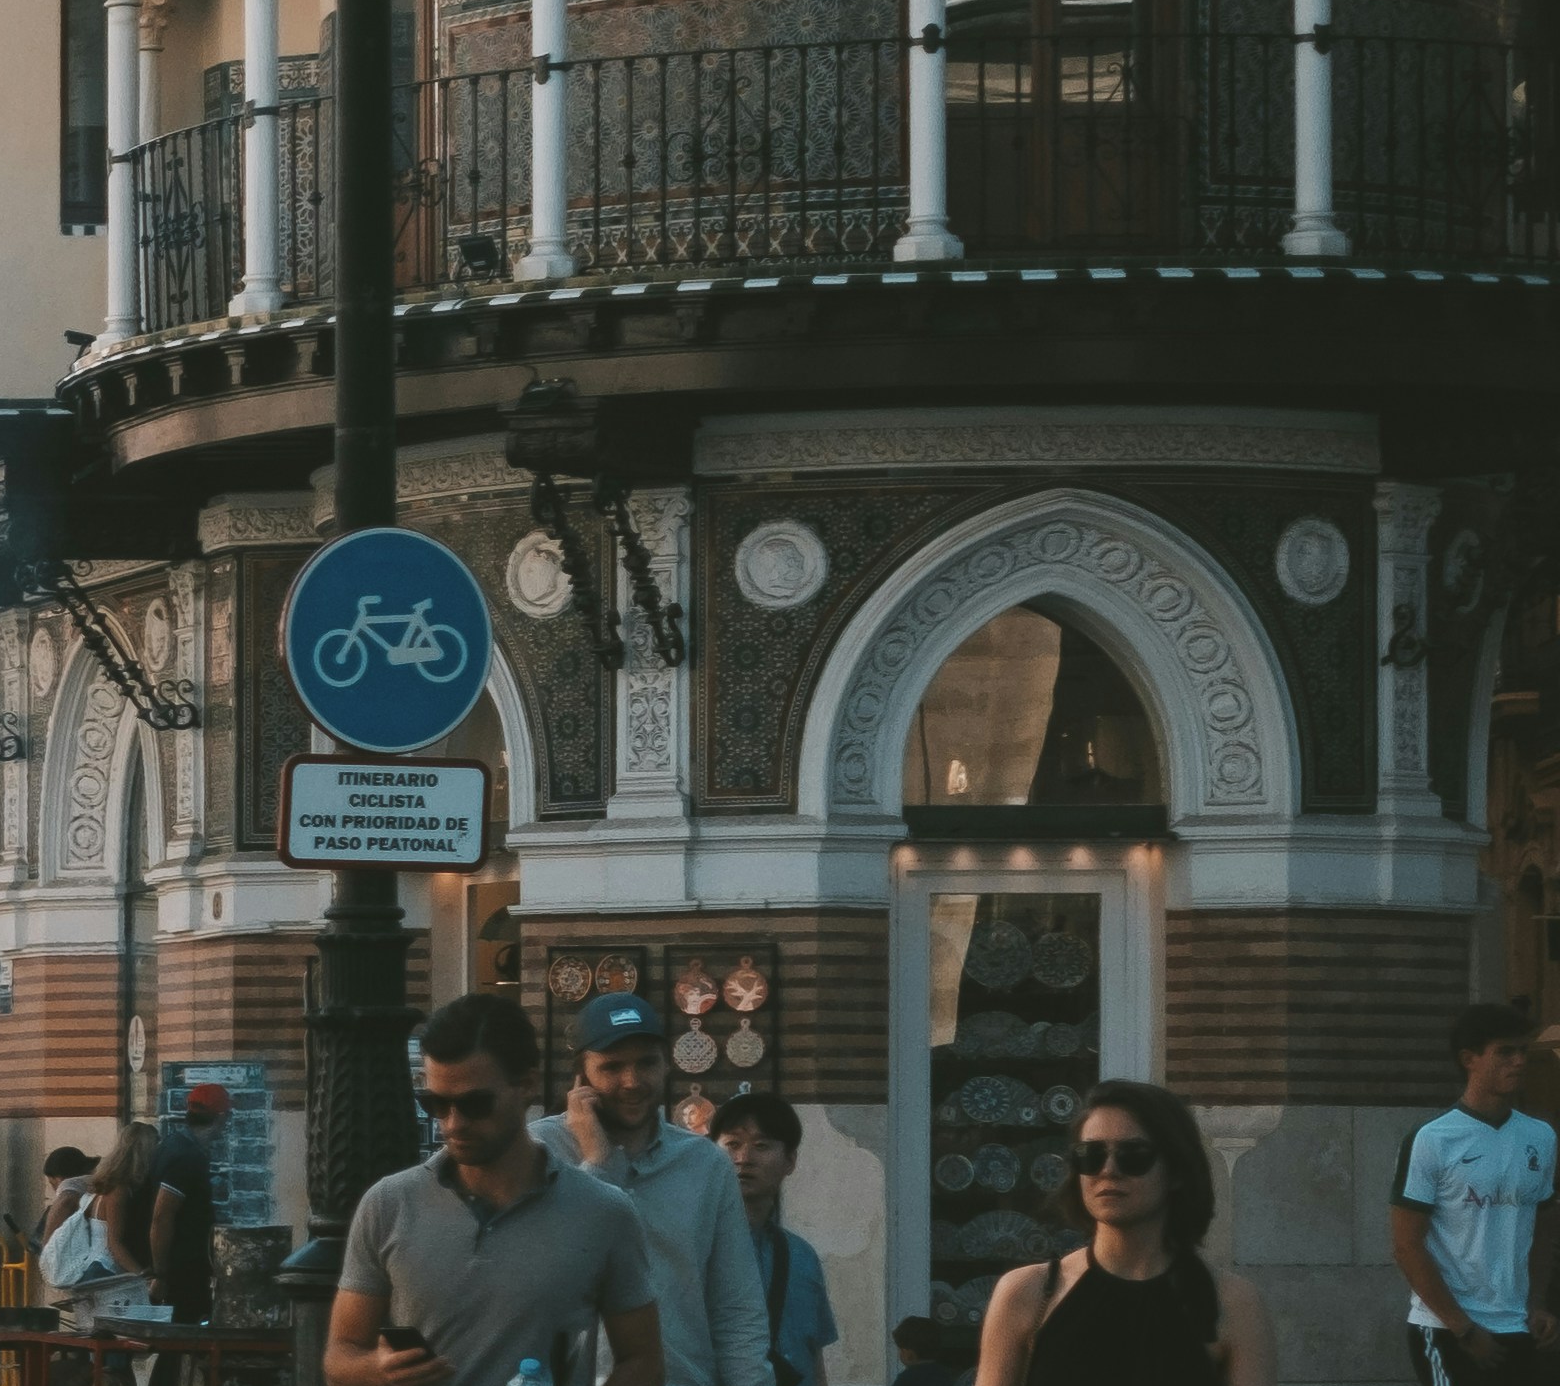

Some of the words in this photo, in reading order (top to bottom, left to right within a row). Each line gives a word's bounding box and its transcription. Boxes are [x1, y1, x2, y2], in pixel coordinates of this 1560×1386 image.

[338, 772, 438, 787] ITINERARIO
[349, 794, 426, 808] CICLISTA
[299, 814, 337, 828] CON
[341, 815, 440, 830] PRIORIDAD
[446, 817, 469, 831] DE
[314, 836, 362, 850] PASO
[367, 837, 457, 852] PEATONAL
